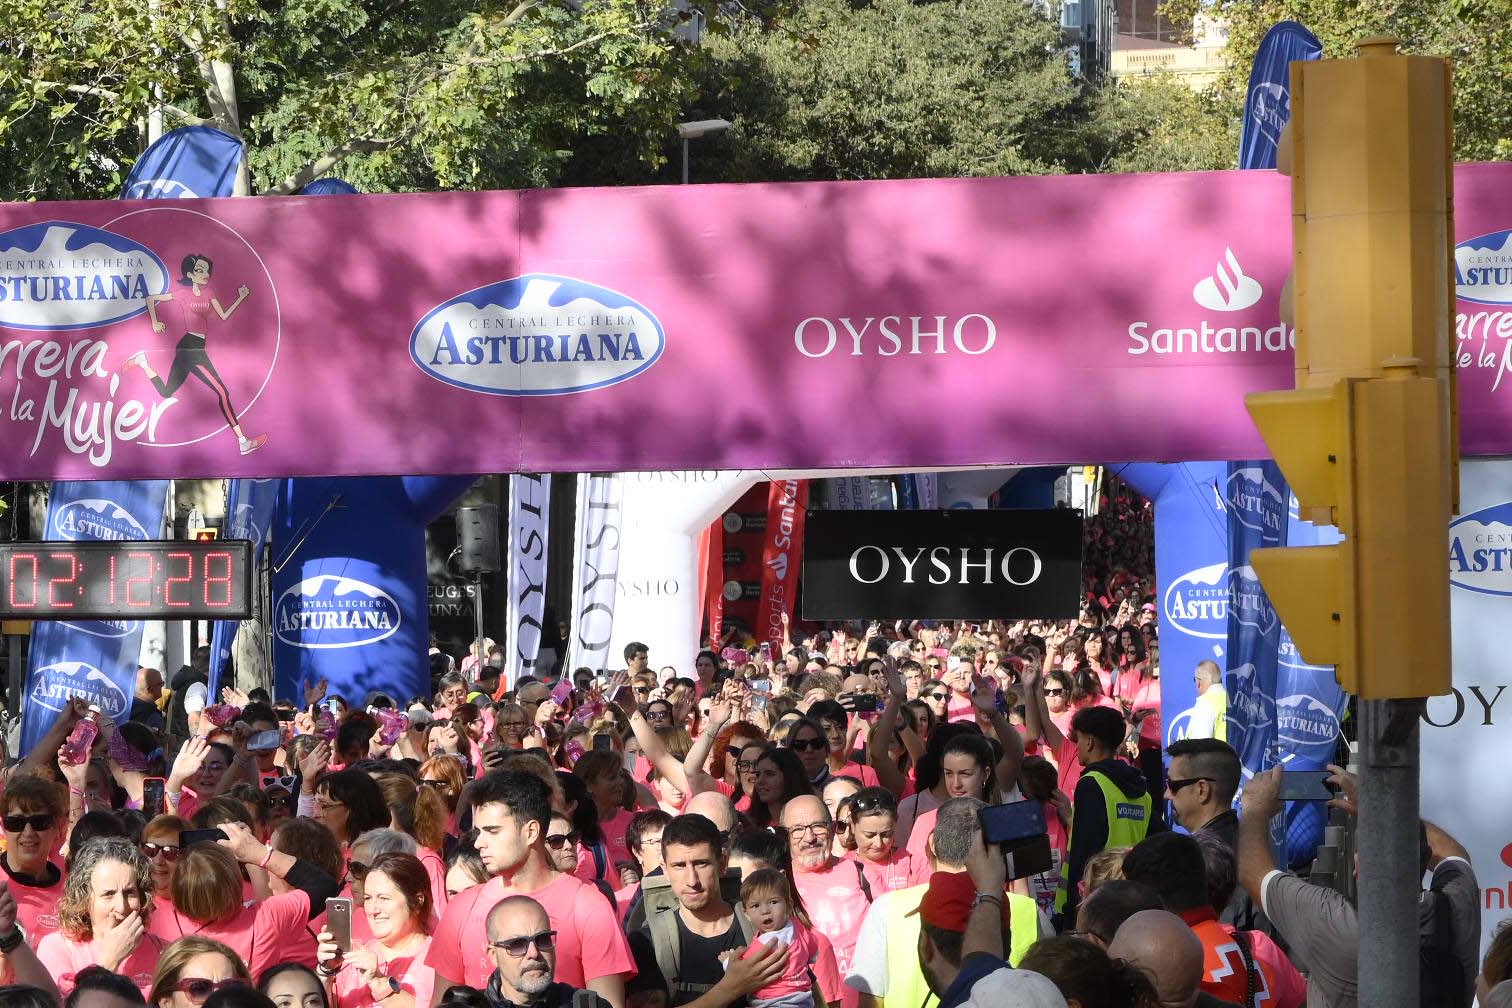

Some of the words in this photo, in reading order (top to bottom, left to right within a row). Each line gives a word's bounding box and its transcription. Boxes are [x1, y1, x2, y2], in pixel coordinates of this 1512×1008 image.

[72, 257, 143, 269] LECHERA
[469, 318, 548, 330] CENTRAL
[556, 315, 636, 327] LECHERA
[794, 313, 997, 358] OYSHO
[430, 322, 645, 365] ASTURIANA
[1479, 341, 1495, 368] la
[10, 383, 34, 422] la
[29, 370, 179, 467] Mujer
[849, 545, 1042, 586] OYSHO
[10, 553, 232, 607] 02:12:28
[617, 579, 679, 597] YSHO
[279, 605, 392, 632] ASTURIANA
[1277, 717, 1333, 738] STURIANA
